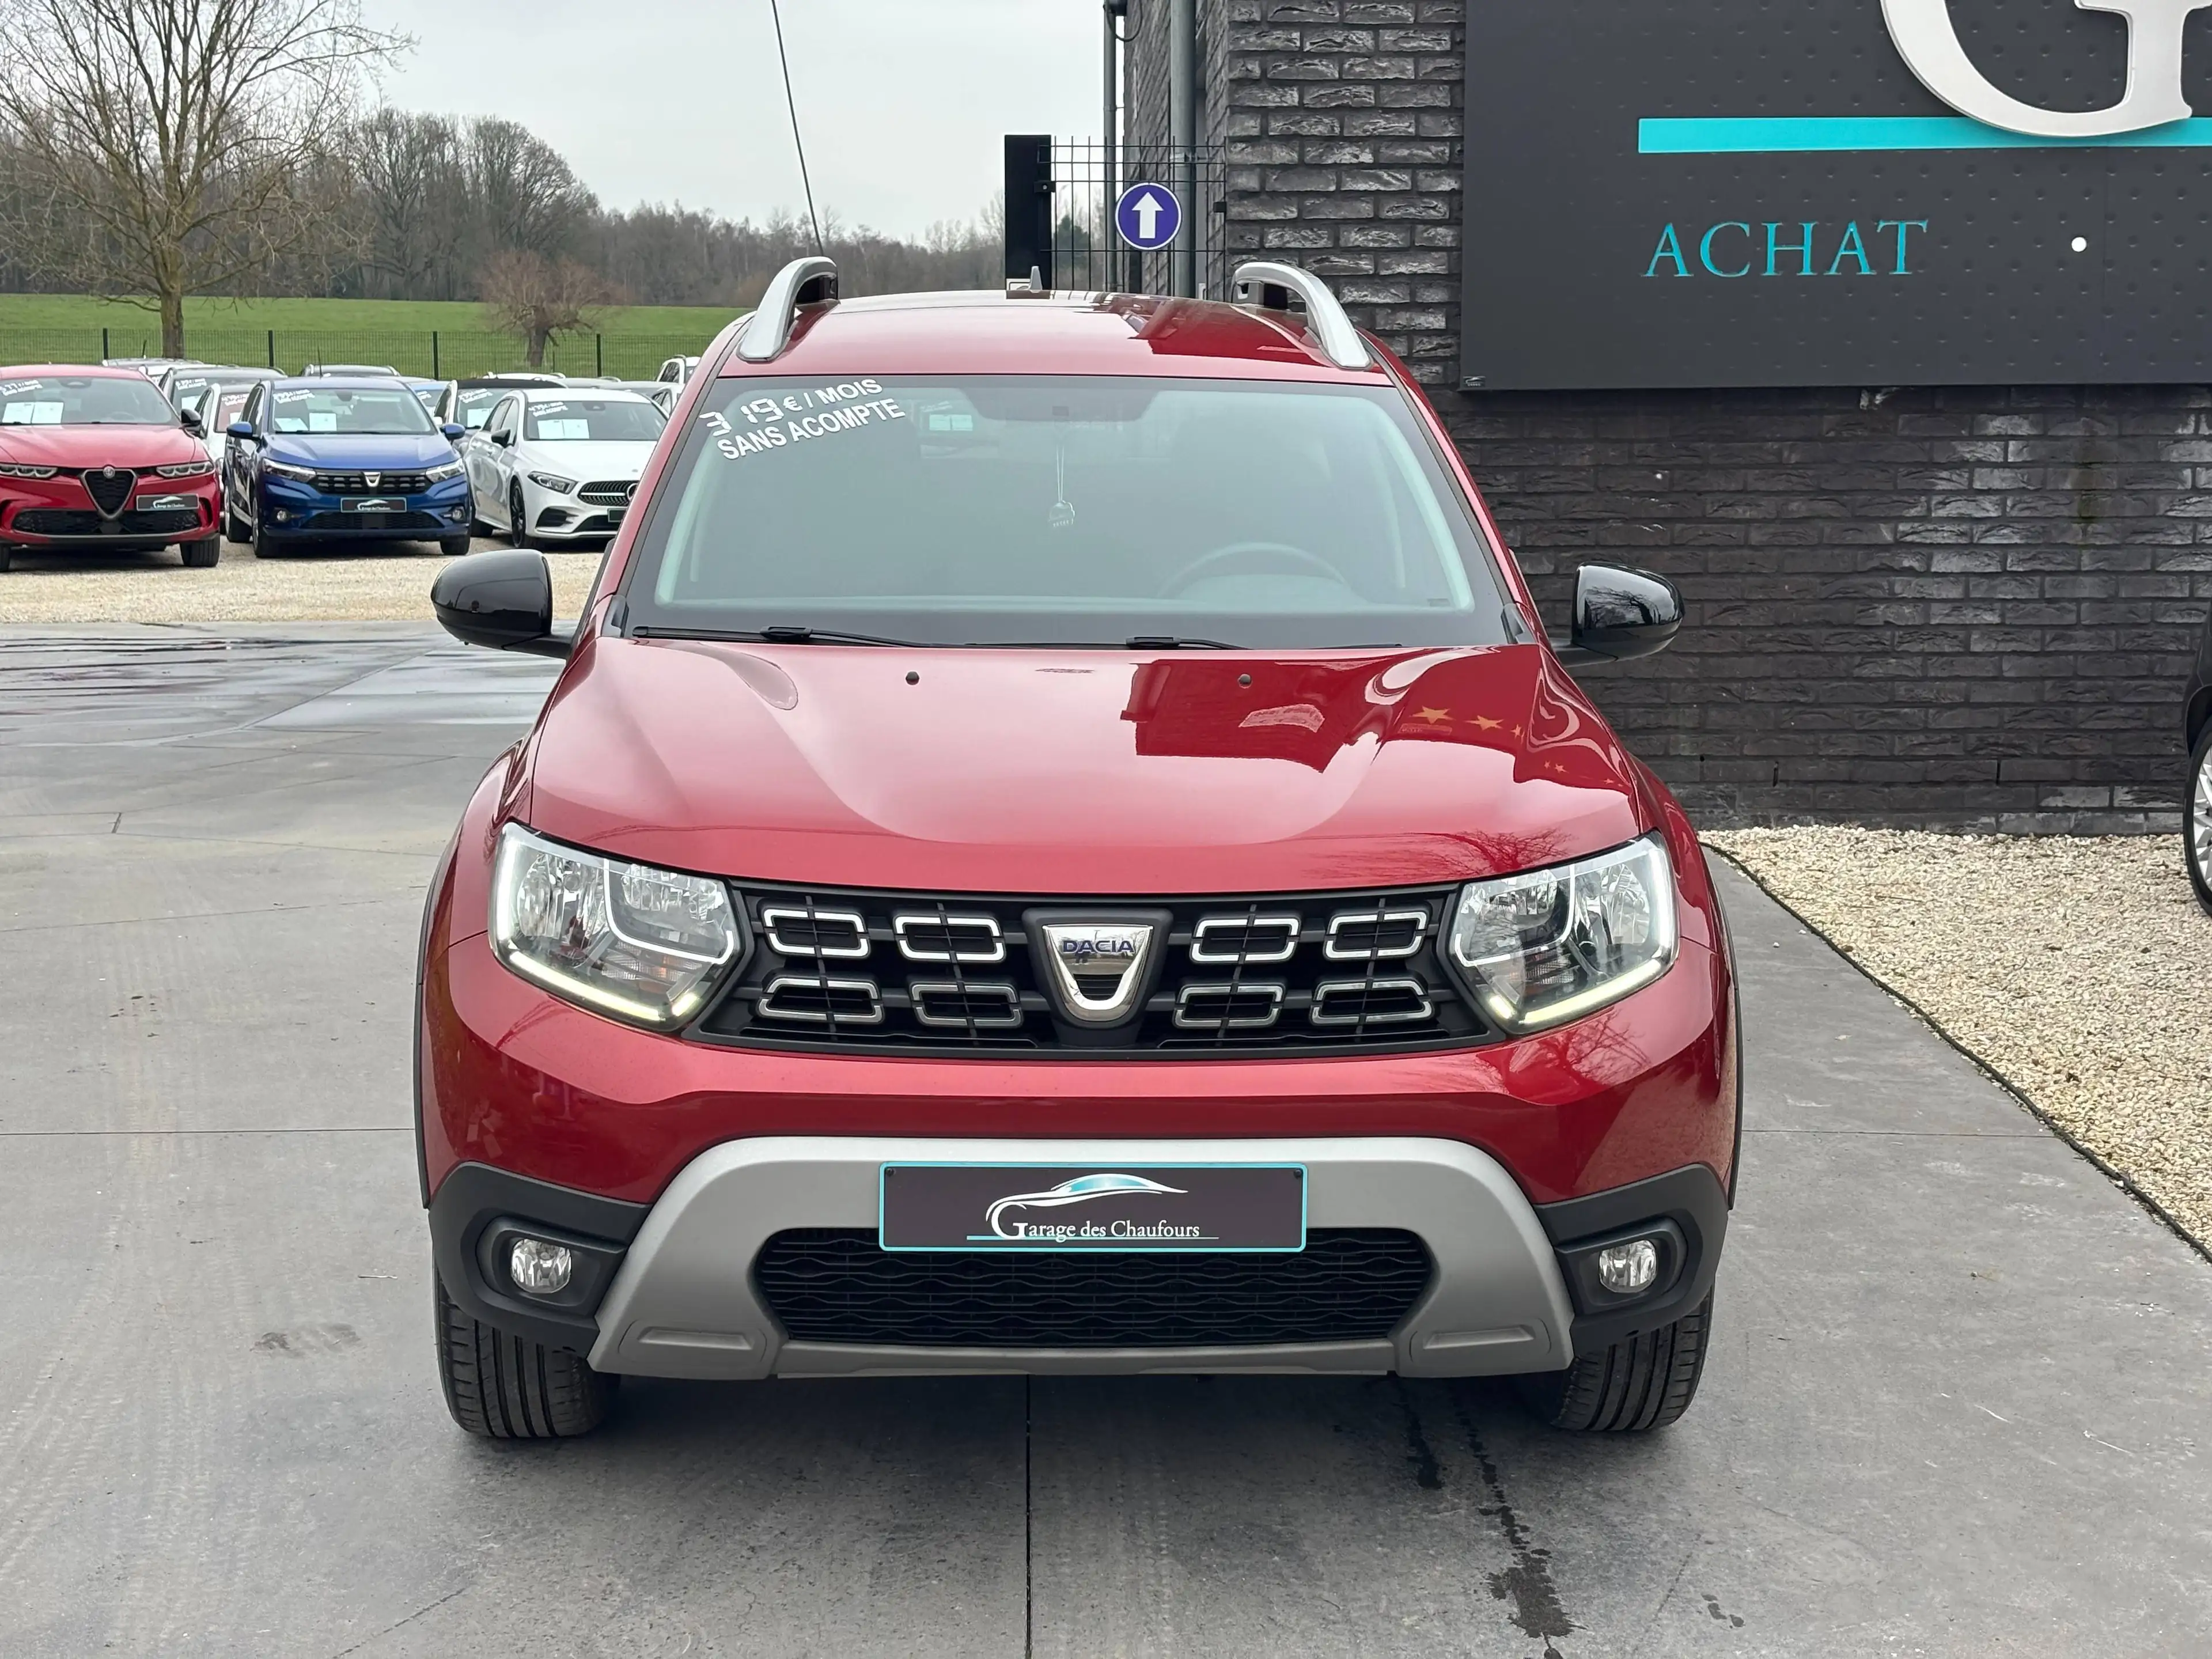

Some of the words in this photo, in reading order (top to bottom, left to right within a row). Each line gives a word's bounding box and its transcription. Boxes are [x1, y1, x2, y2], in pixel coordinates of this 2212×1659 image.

[1639, 219, 1928, 276] ACHAT
[815, 378, 882, 404] MOIS
[717, 426, 787, 460] SANS
[787, 398, 906, 442] ACOMPTE
[1062, 940, 1135, 955] DACIA
[991, 1204, 1076, 1243] Garage
[1080, 1221, 1107, 1237] des
[1111, 1219, 1200, 1237] Chaufours
